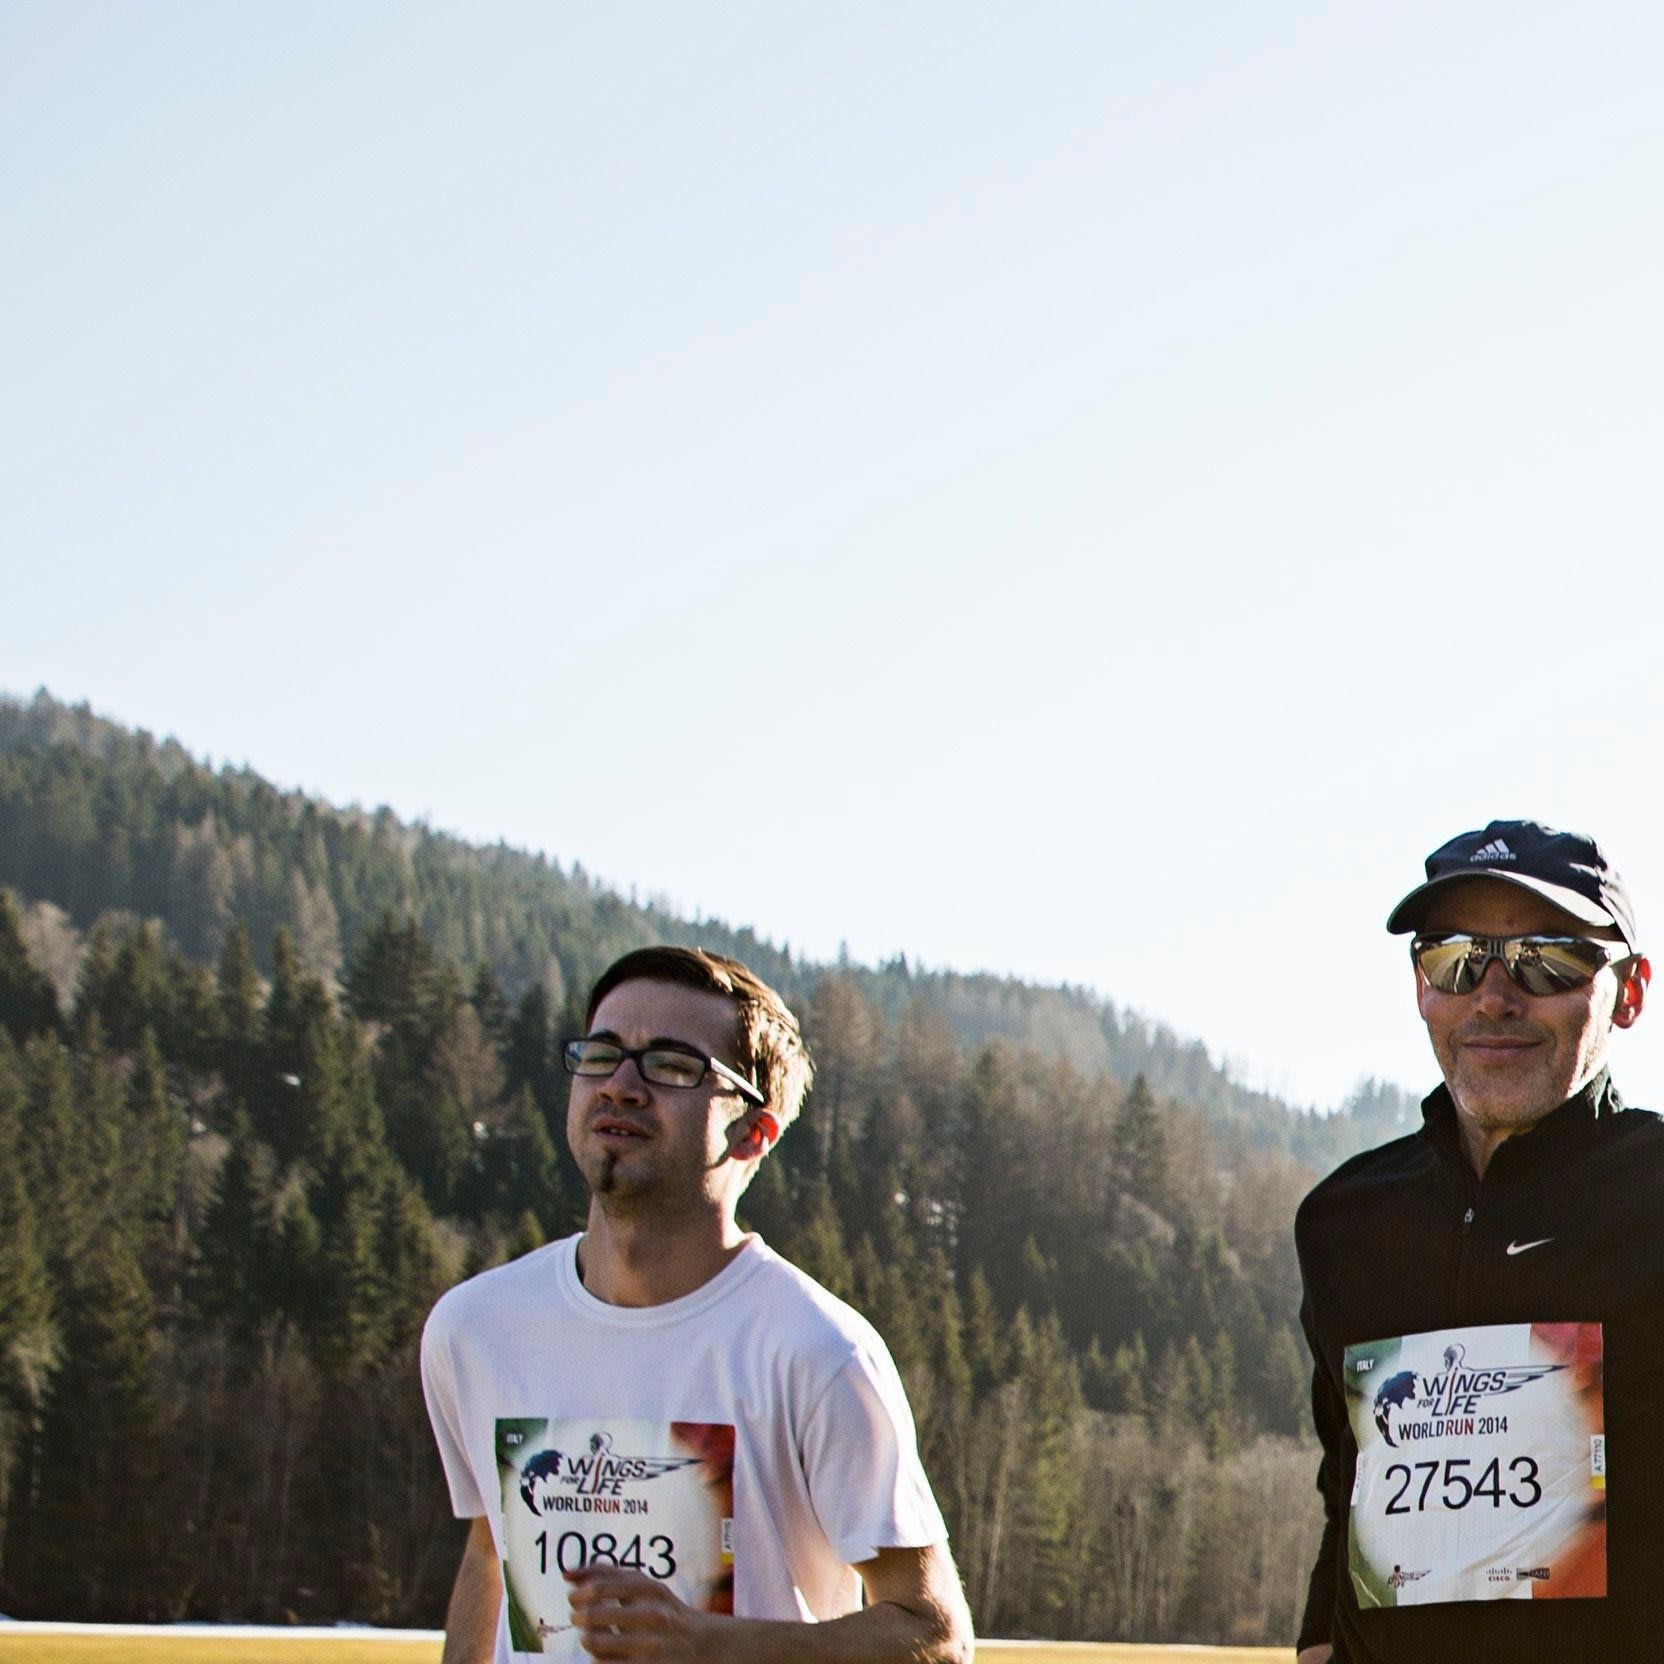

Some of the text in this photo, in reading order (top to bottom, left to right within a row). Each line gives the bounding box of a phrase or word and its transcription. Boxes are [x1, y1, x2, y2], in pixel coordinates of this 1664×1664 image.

[1470, 851, 1517, 862] adidas
[1422, 1371, 1507, 1397] WINGS
[1417, 1394, 1482, 1417] FOR LIFE
[1478, 1415, 1509, 1435] 2014
[567, 1456, 647, 1478] WINGS
[576, 1477, 626, 1496] LIFE
[1385, 1456, 1542, 1515] 27543
[623, 1498, 649, 1514] 2014
[535, 1530, 677, 1580] 10843
